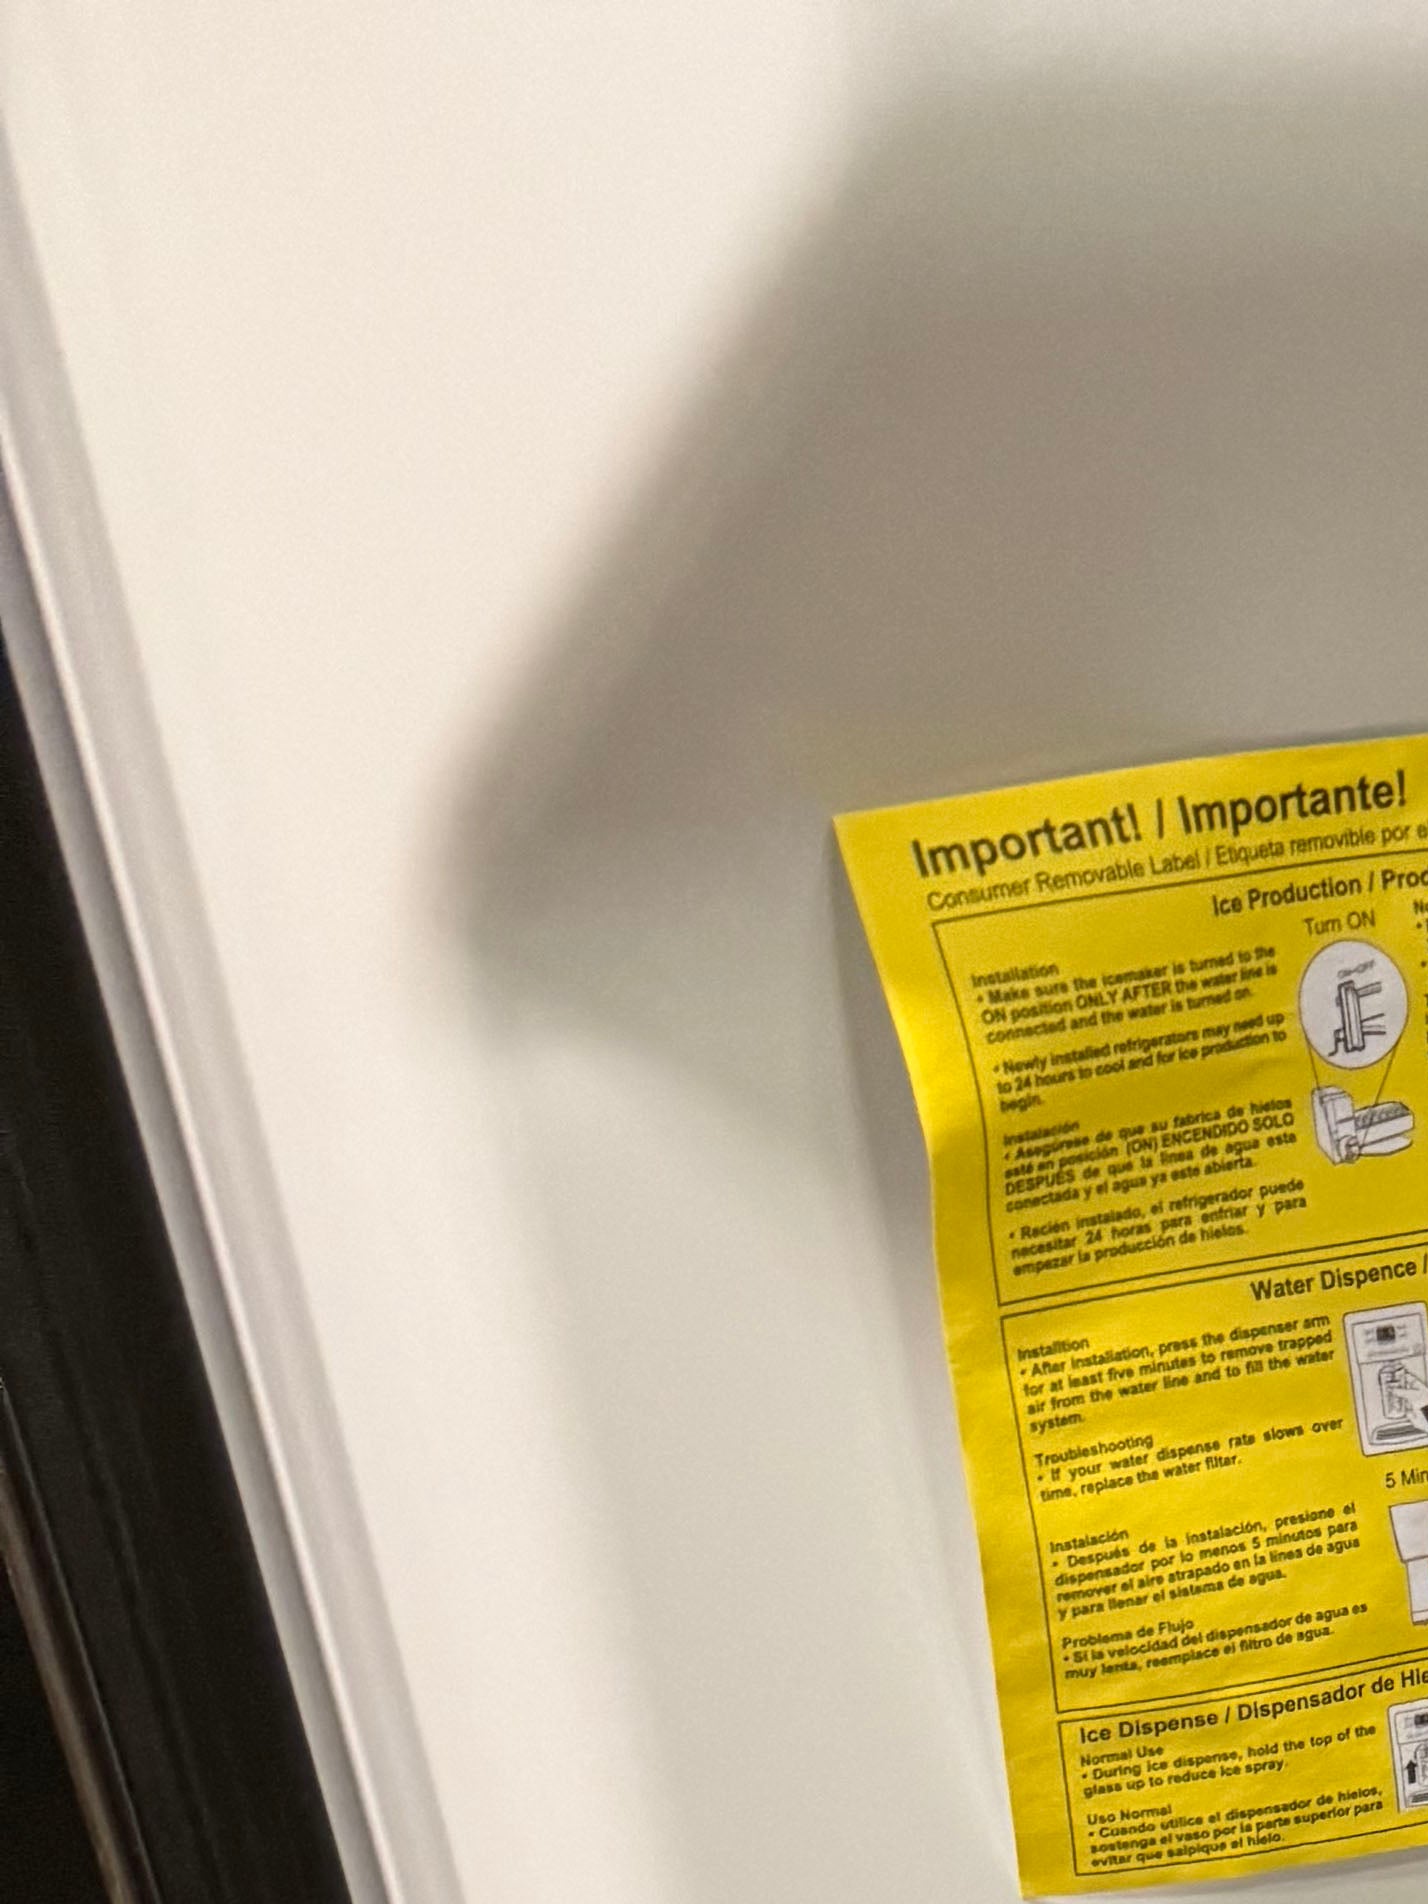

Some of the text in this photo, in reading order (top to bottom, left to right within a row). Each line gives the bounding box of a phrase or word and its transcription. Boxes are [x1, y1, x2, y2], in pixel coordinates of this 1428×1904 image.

[911, 768, 1406, 878] Important! / Importante!
[925, 877, 1031, 912] Consumer
[1033, 858, 1145, 893] Removable
[1147, 848, 1201, 876] Label
[1214, 839, 1285, 867] Etiqueta
[1288, 825, 1376, 856] removible
[1379, 823, 1411, 848] por
[1211, 894, 1243, 917] Ice
[1246, 875, 1362, 910] Production
[1302, 908, 1376, 936] Turn ON
[1249, 1276, 1315, 1301] Water
[1319, 1260, 1417, 1290] Dispence
[1384, 1471, 1397, 1489] 5
[1079, 1726, 1111, 1744] Ice
[1117, 1712, 1219, 1738] Dispense
[1236, 1682, 1366, 1721] Dispensador
[1369, 1674, 1395, 1694] de
